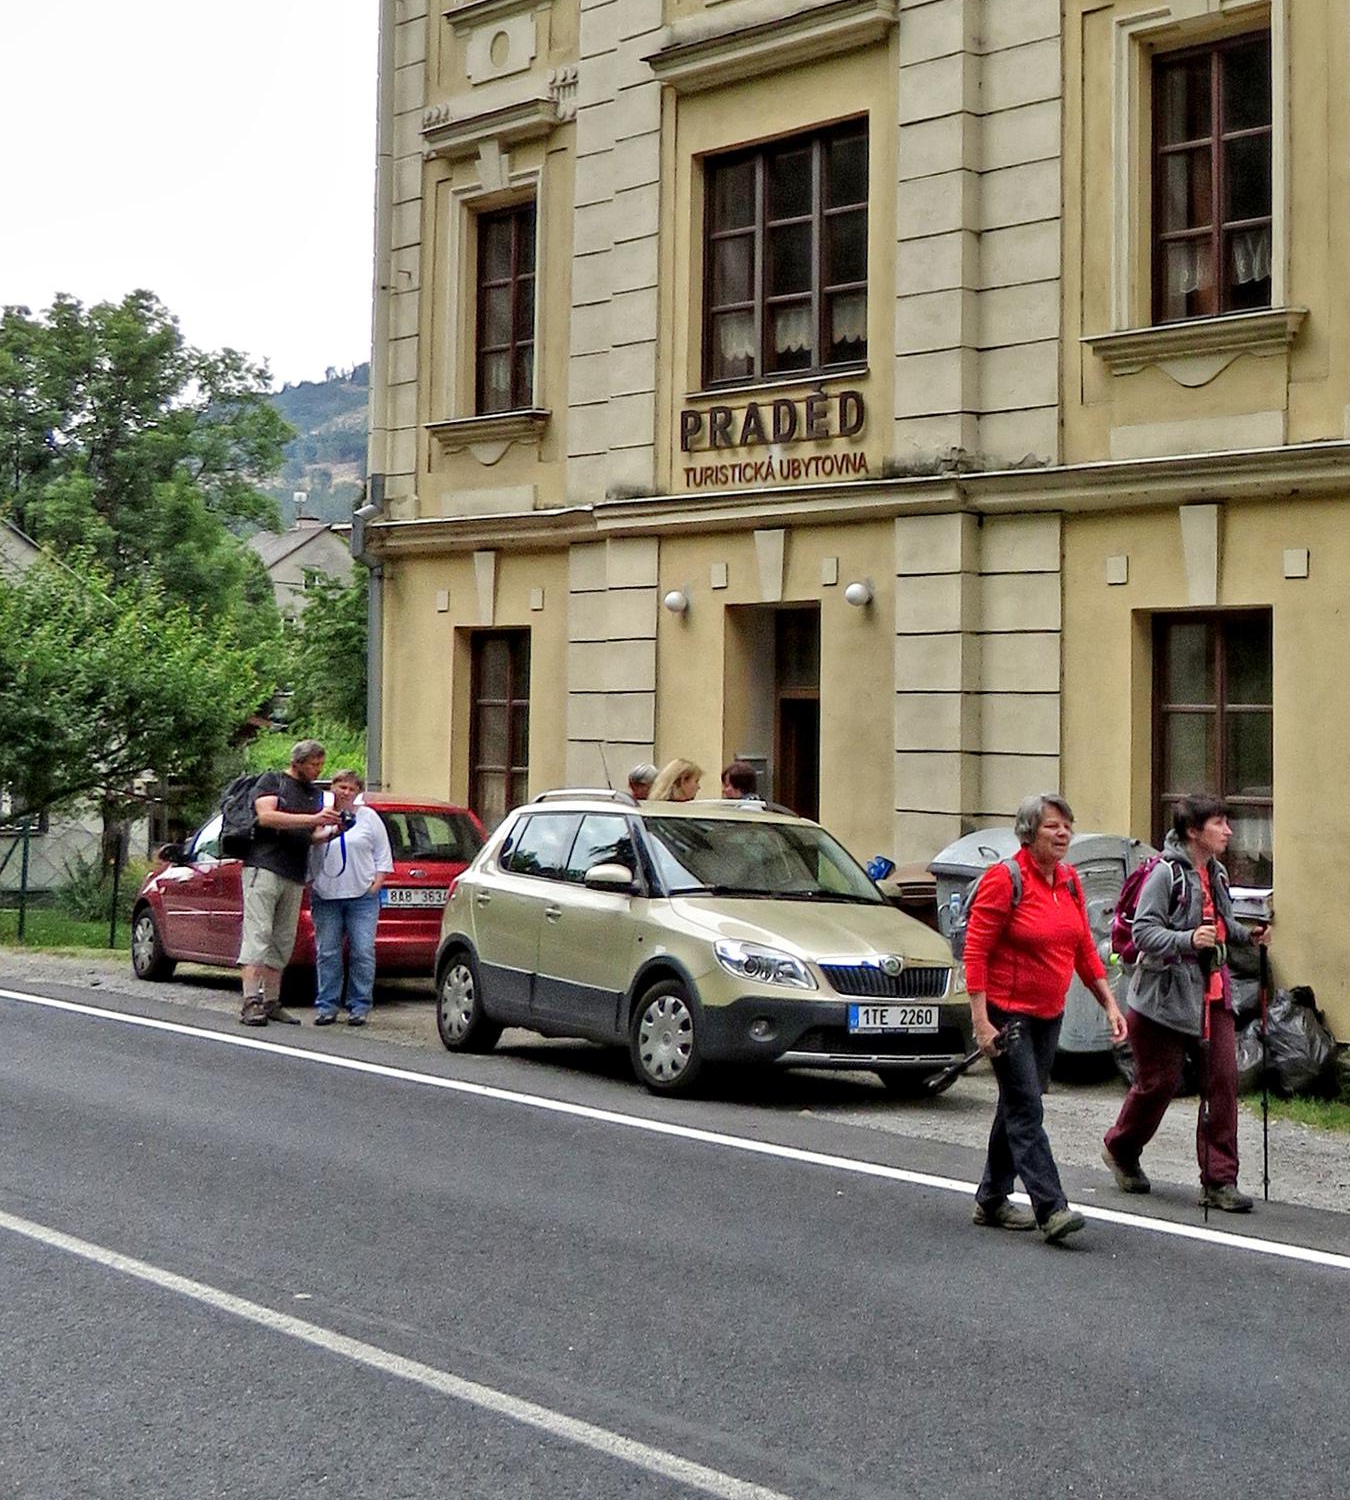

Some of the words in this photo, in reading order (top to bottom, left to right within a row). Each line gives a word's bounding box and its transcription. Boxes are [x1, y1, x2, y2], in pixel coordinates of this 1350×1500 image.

[681, 383, 865, 452] PRADĚD
[683, 455, 776, 488] TURISTICKÁ
[779, 452, 869, 480] UBYTOVNA
[863, 1008, 889, 1025] 1TE
[900, 1008, 932, 1025] 2260
